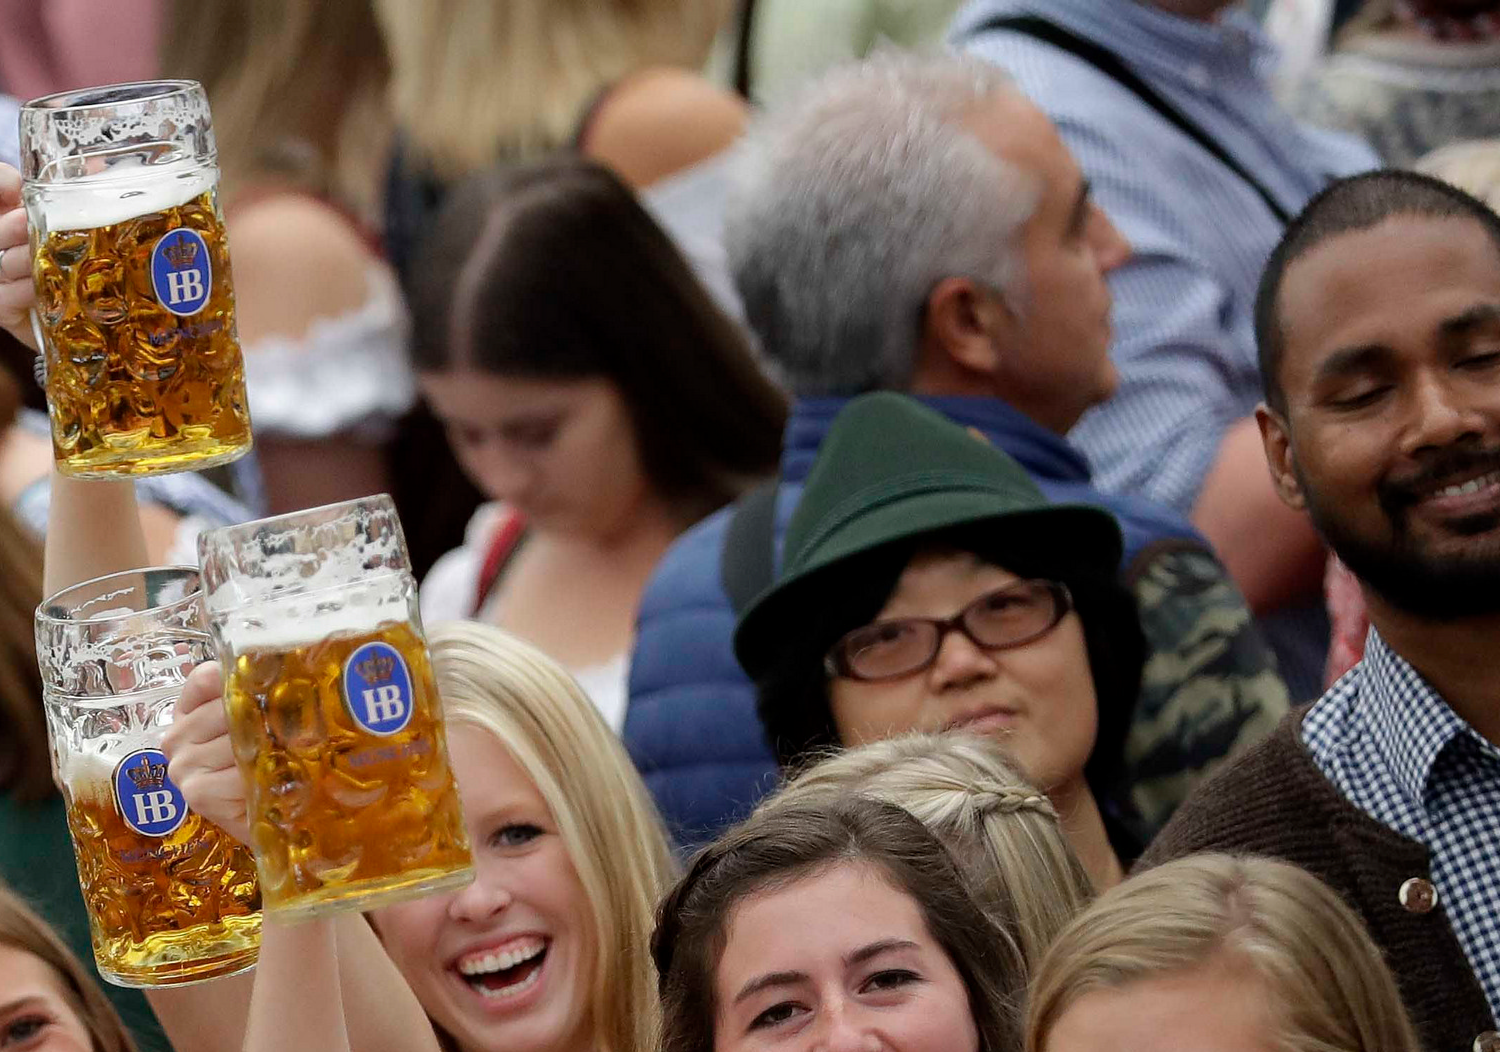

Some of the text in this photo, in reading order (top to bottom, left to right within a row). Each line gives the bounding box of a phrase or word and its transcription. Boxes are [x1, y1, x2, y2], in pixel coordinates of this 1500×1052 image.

[166, 268, 203, 304] HB
[362, 684, 405, 724] HB
[132, 789, 177, 825] HB
